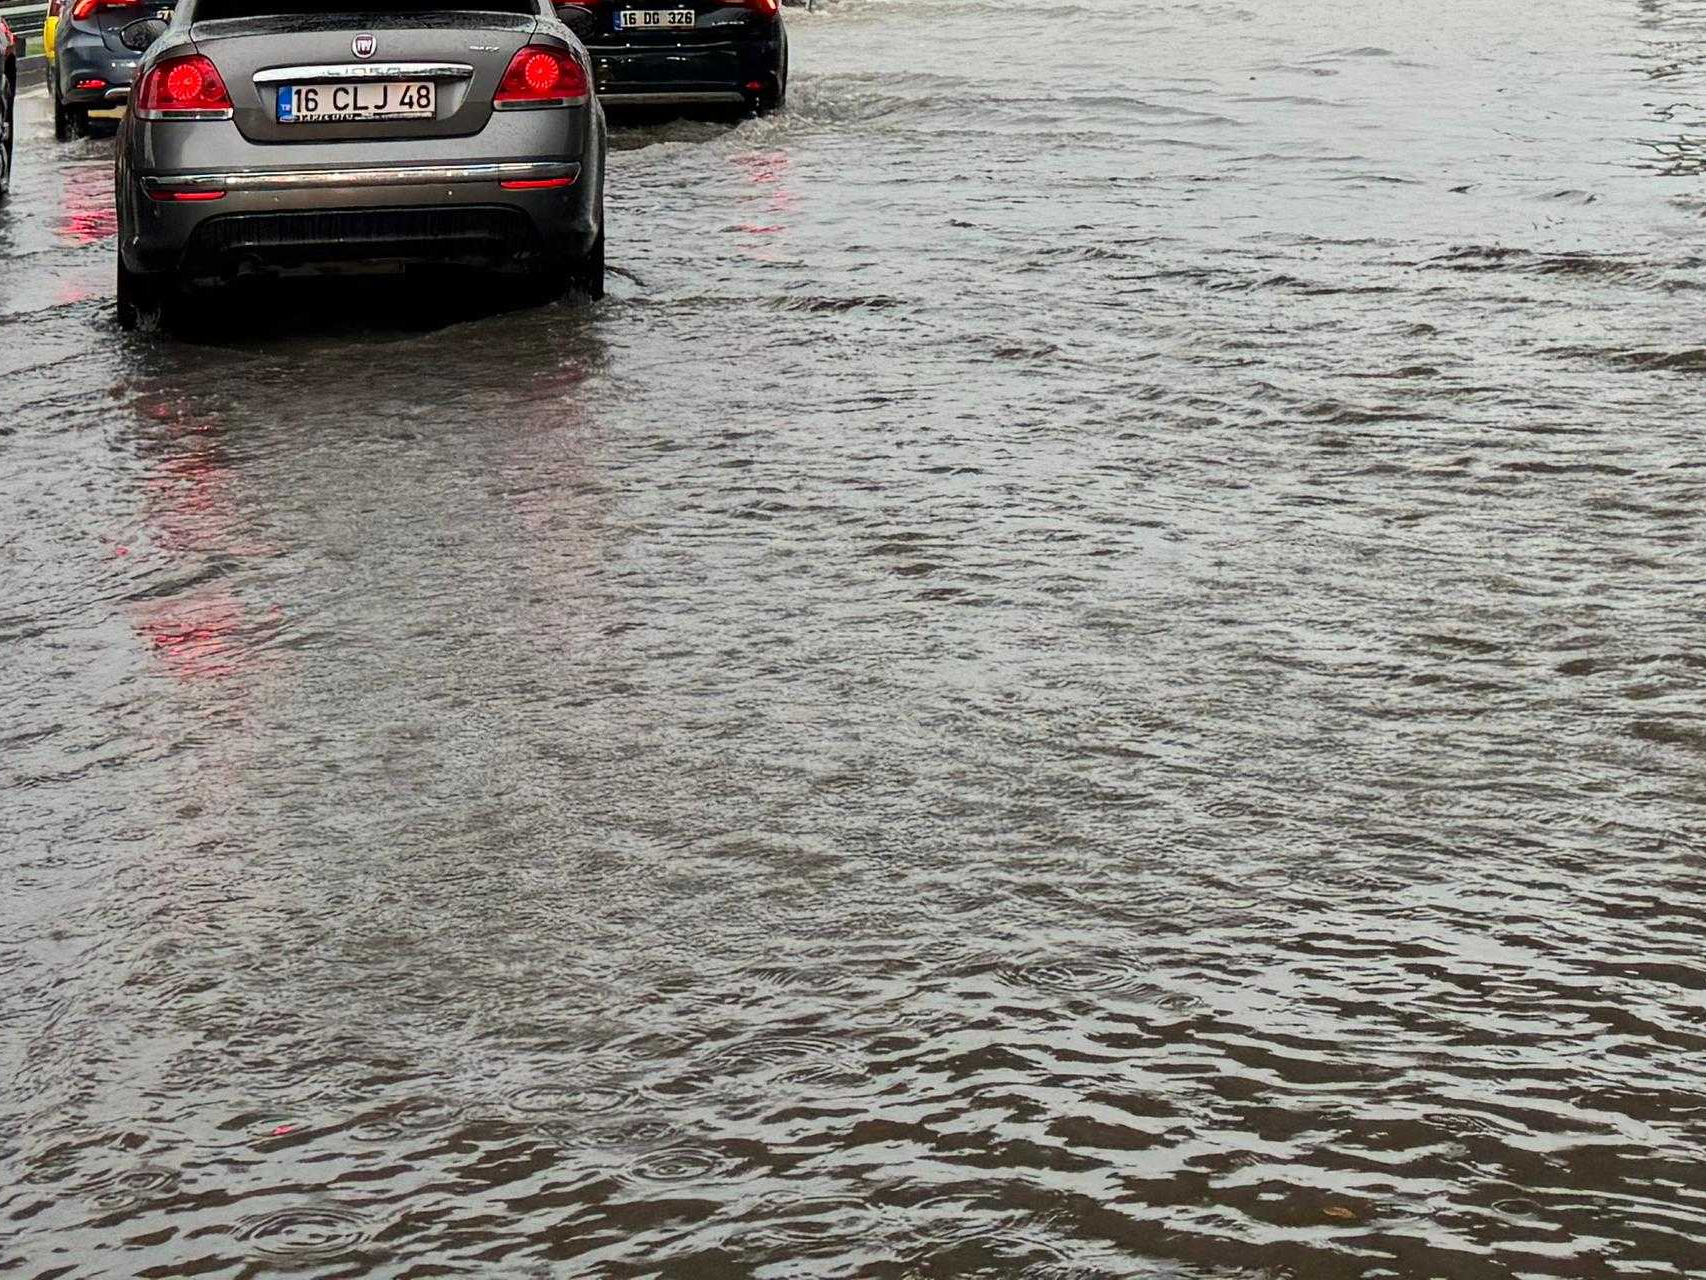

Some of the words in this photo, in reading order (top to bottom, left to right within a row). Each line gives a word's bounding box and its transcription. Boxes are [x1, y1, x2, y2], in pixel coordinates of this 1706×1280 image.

[668, 11, 693, 25] 326
[294, 88, 319, 113] 16
[333, 86, 388, 111] CLJ
[399, 85, 431, 110] 48
